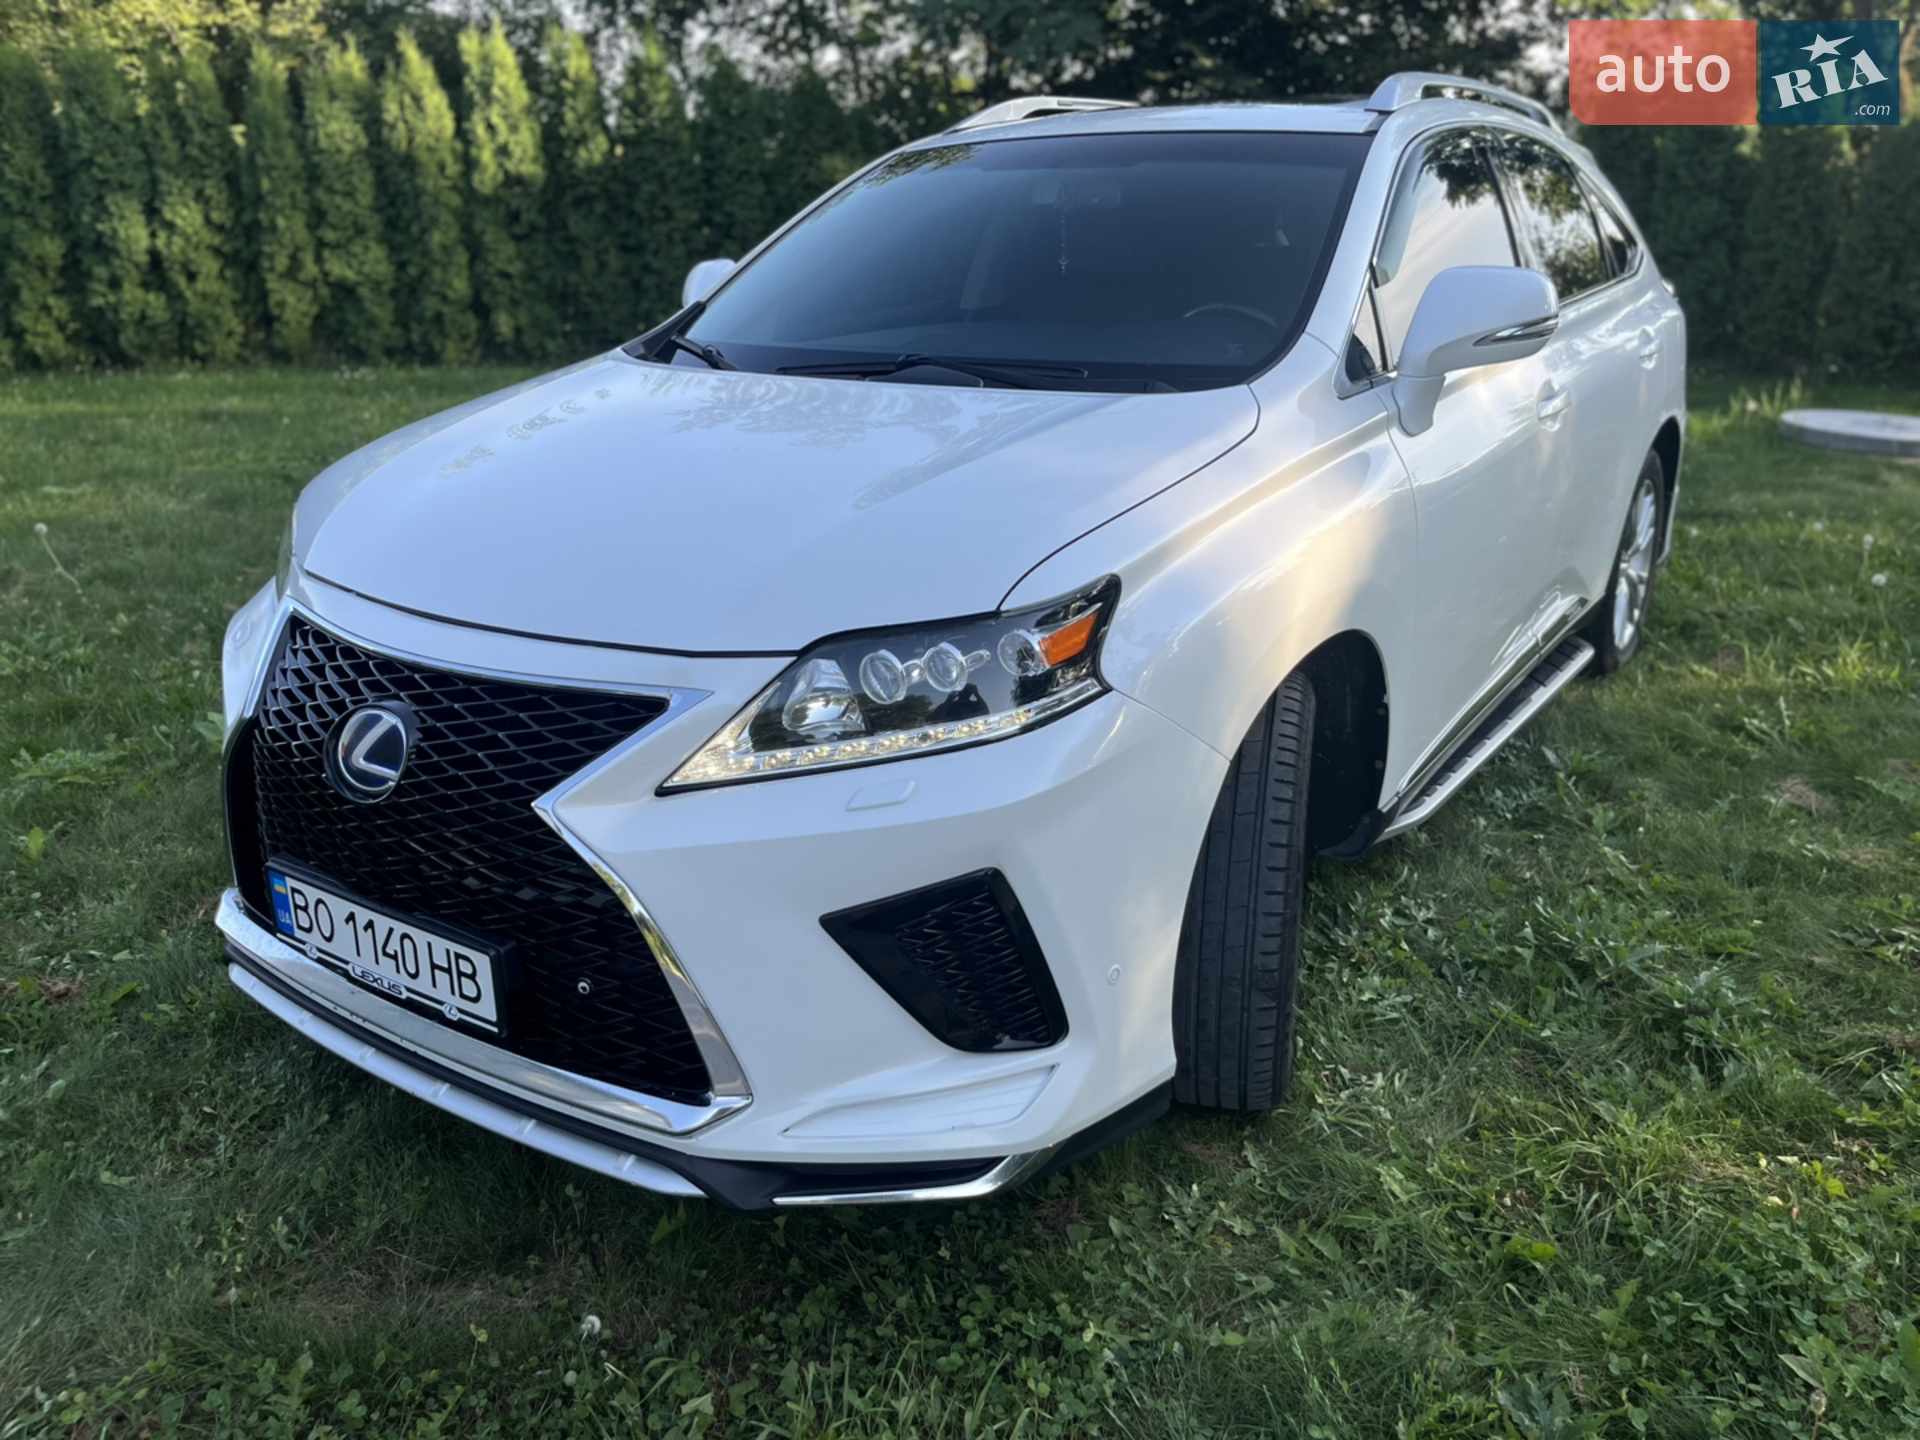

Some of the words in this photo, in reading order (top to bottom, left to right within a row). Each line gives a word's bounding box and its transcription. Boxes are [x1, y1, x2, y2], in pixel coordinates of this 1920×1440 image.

[278, 910, 292, 926] UA
[291, 887, 334, 943] BO
[344, 911, 420, 980] 1140
[427, 940, 482, 1004] HB
[351, 965, 403, 997] LEXUS
